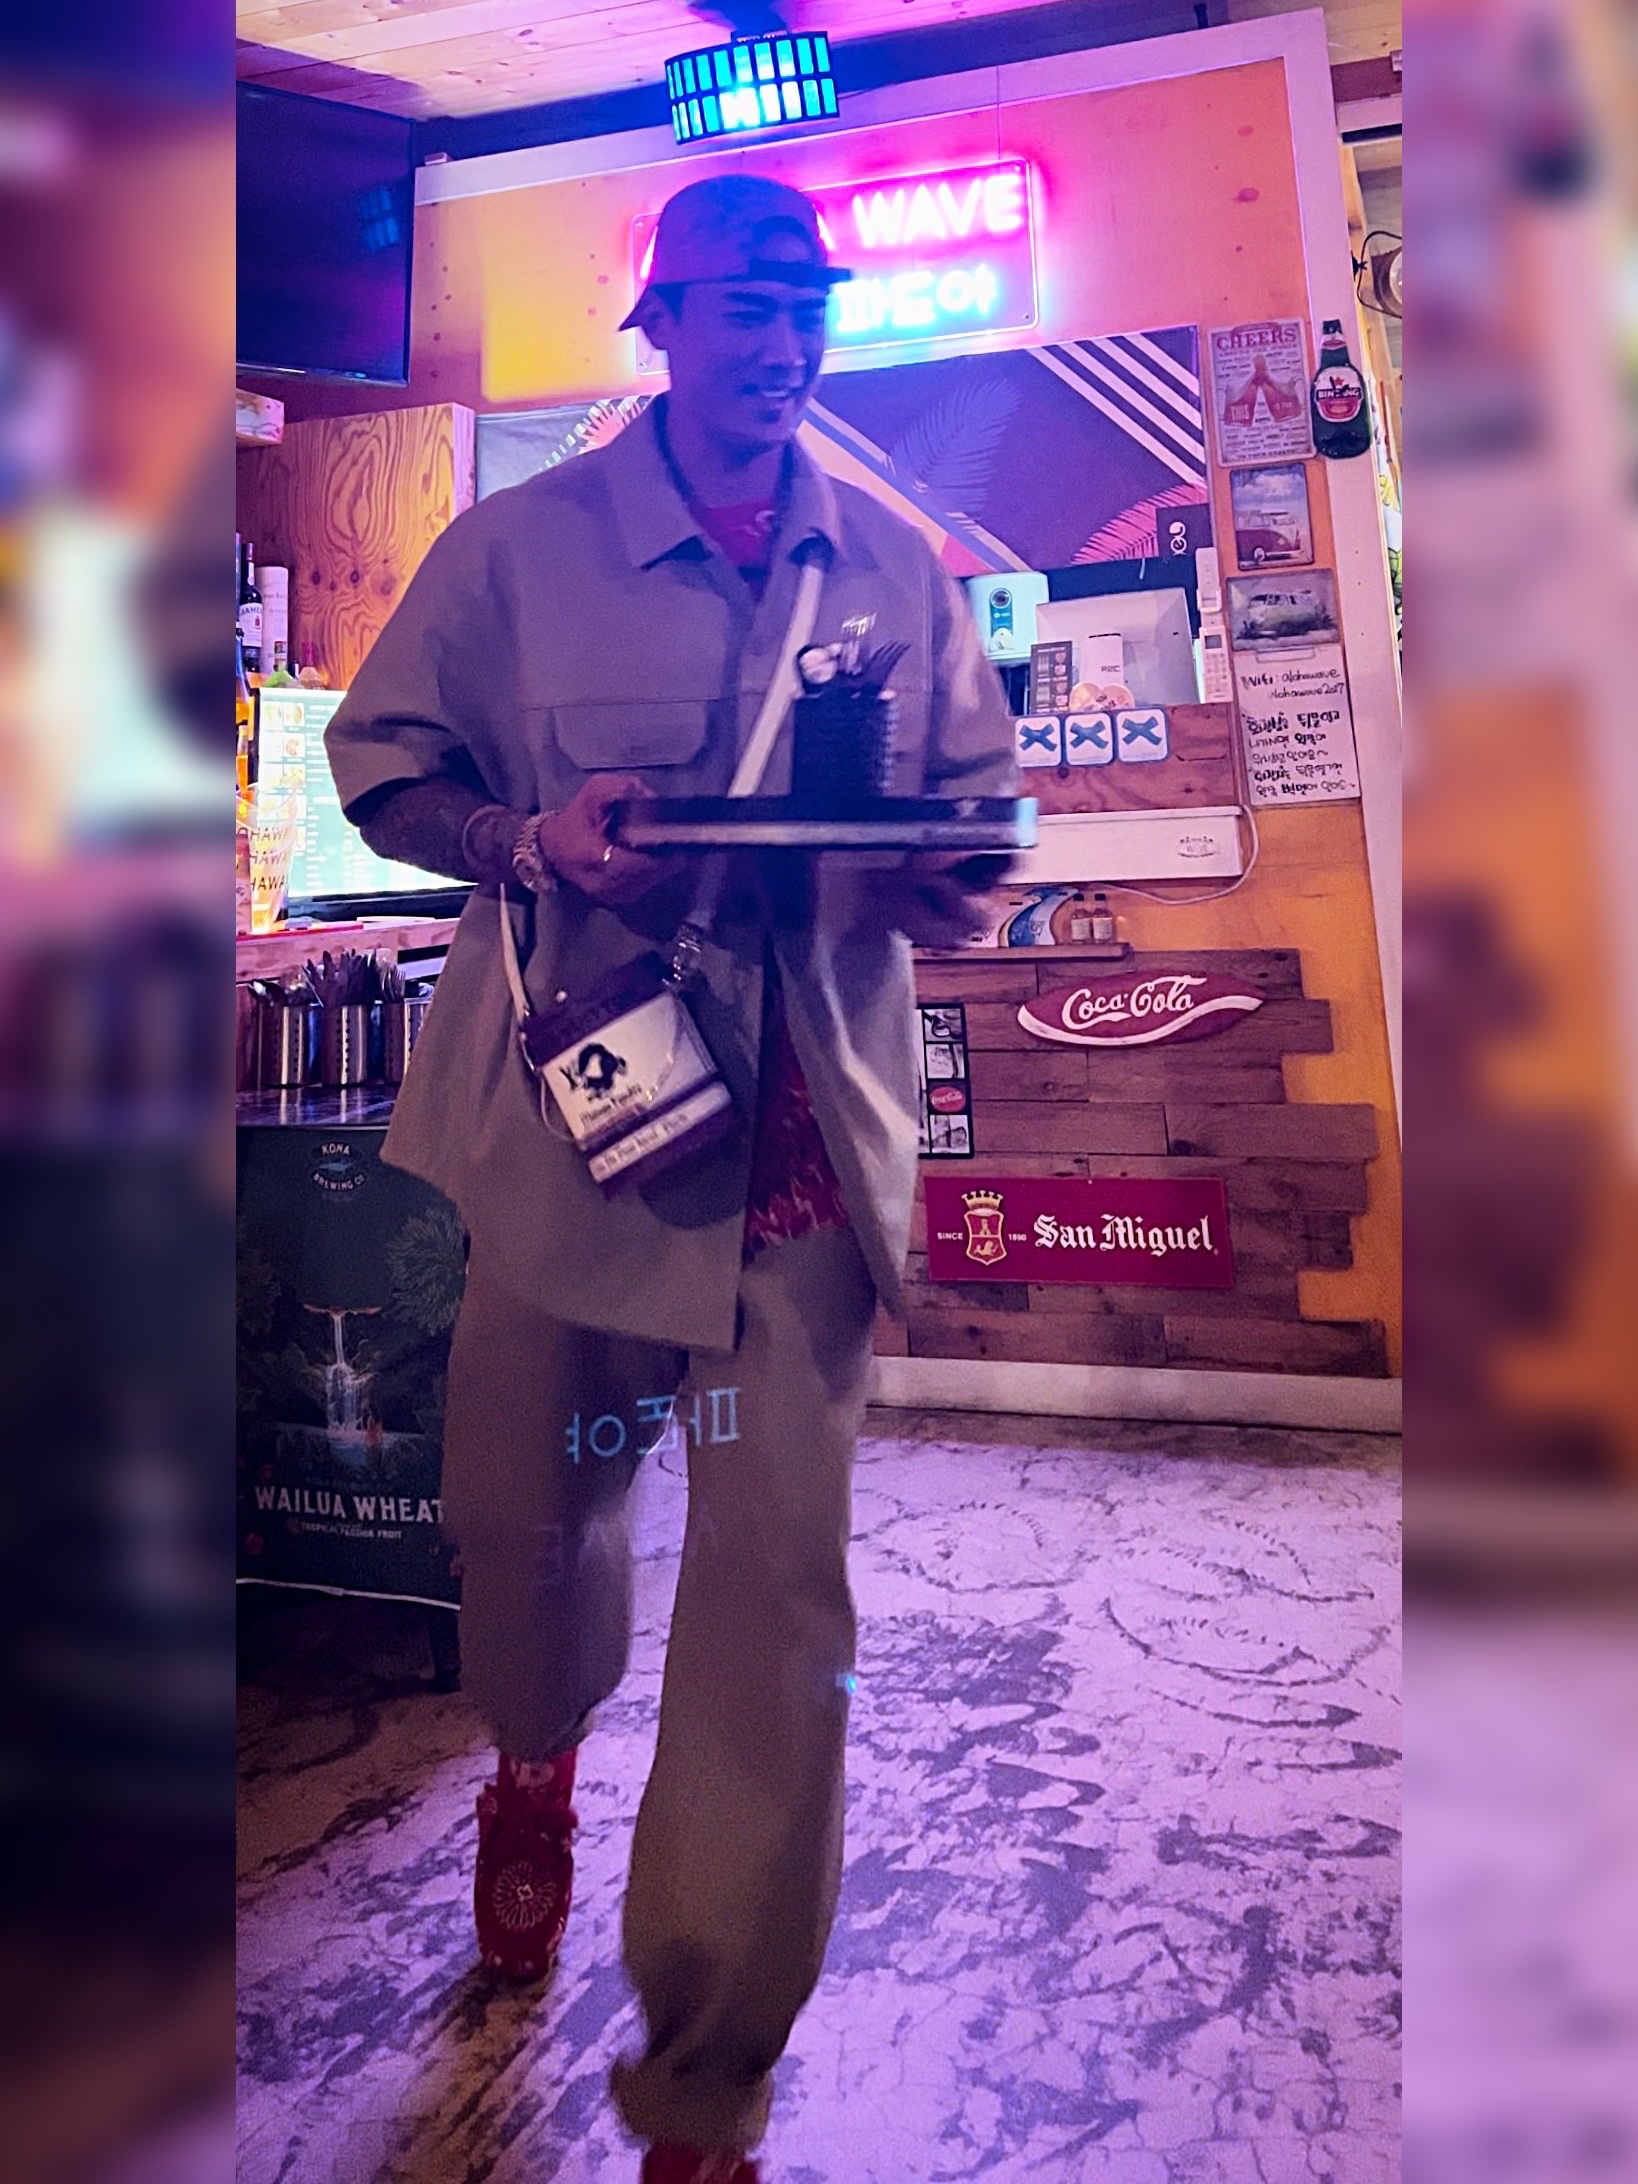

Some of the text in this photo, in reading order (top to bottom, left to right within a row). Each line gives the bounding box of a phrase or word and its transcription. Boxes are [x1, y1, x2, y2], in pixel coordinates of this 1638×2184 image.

[853, 174, 1022, 248] WAVE
[1216, 327, 1297, 351] CHEERS
[1061, 975, 1208, 1031] Coca-Cola
[321, 1142, 350, 1156] KONA
[313, 1172, 354, 1191] BREWING
[937, 1231, 964, 1240] SINCE
[1033, 1212, 1215, 1258] San Miguel
[254, 1485, 445, 1524] WAILUA WHEAT
